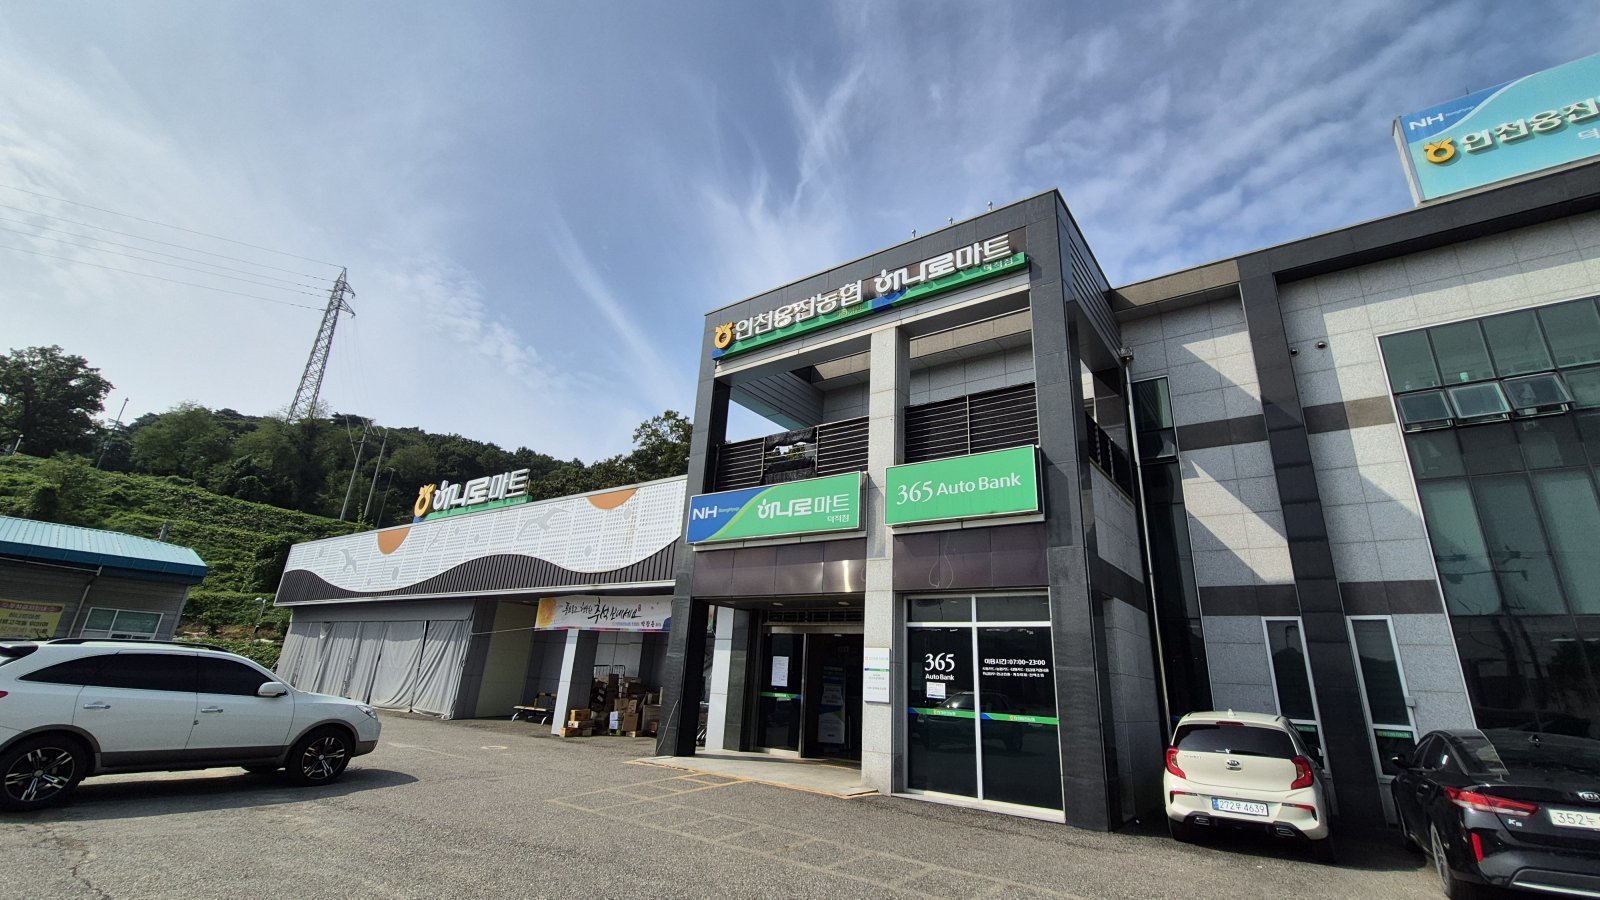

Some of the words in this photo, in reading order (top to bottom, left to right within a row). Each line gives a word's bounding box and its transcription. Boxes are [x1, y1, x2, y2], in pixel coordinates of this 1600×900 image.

[1409, 113, 1444, 130] NH
[1461, 95, 1600, 153] 인천옹진
[735, 279, 864, 341] 인천옹진농협
[874, 234, 1012, 293] 하나로마트
[433, 468, 530, 511] 하나로마트
[896, 480, 933, 505] 365
[937, 481, 975, 497] Auto
[978, 472, 1022, 491] Bank
[693, 506, 717, 520] NH
[758, 493, 849, 519] 하나로마트
[588, 597, 610, 624] 추석
[610, 606, 642, 620] 보내세요
[925, 652, 955, 672] 365
[1244, 803, 1265, 813] 4639
